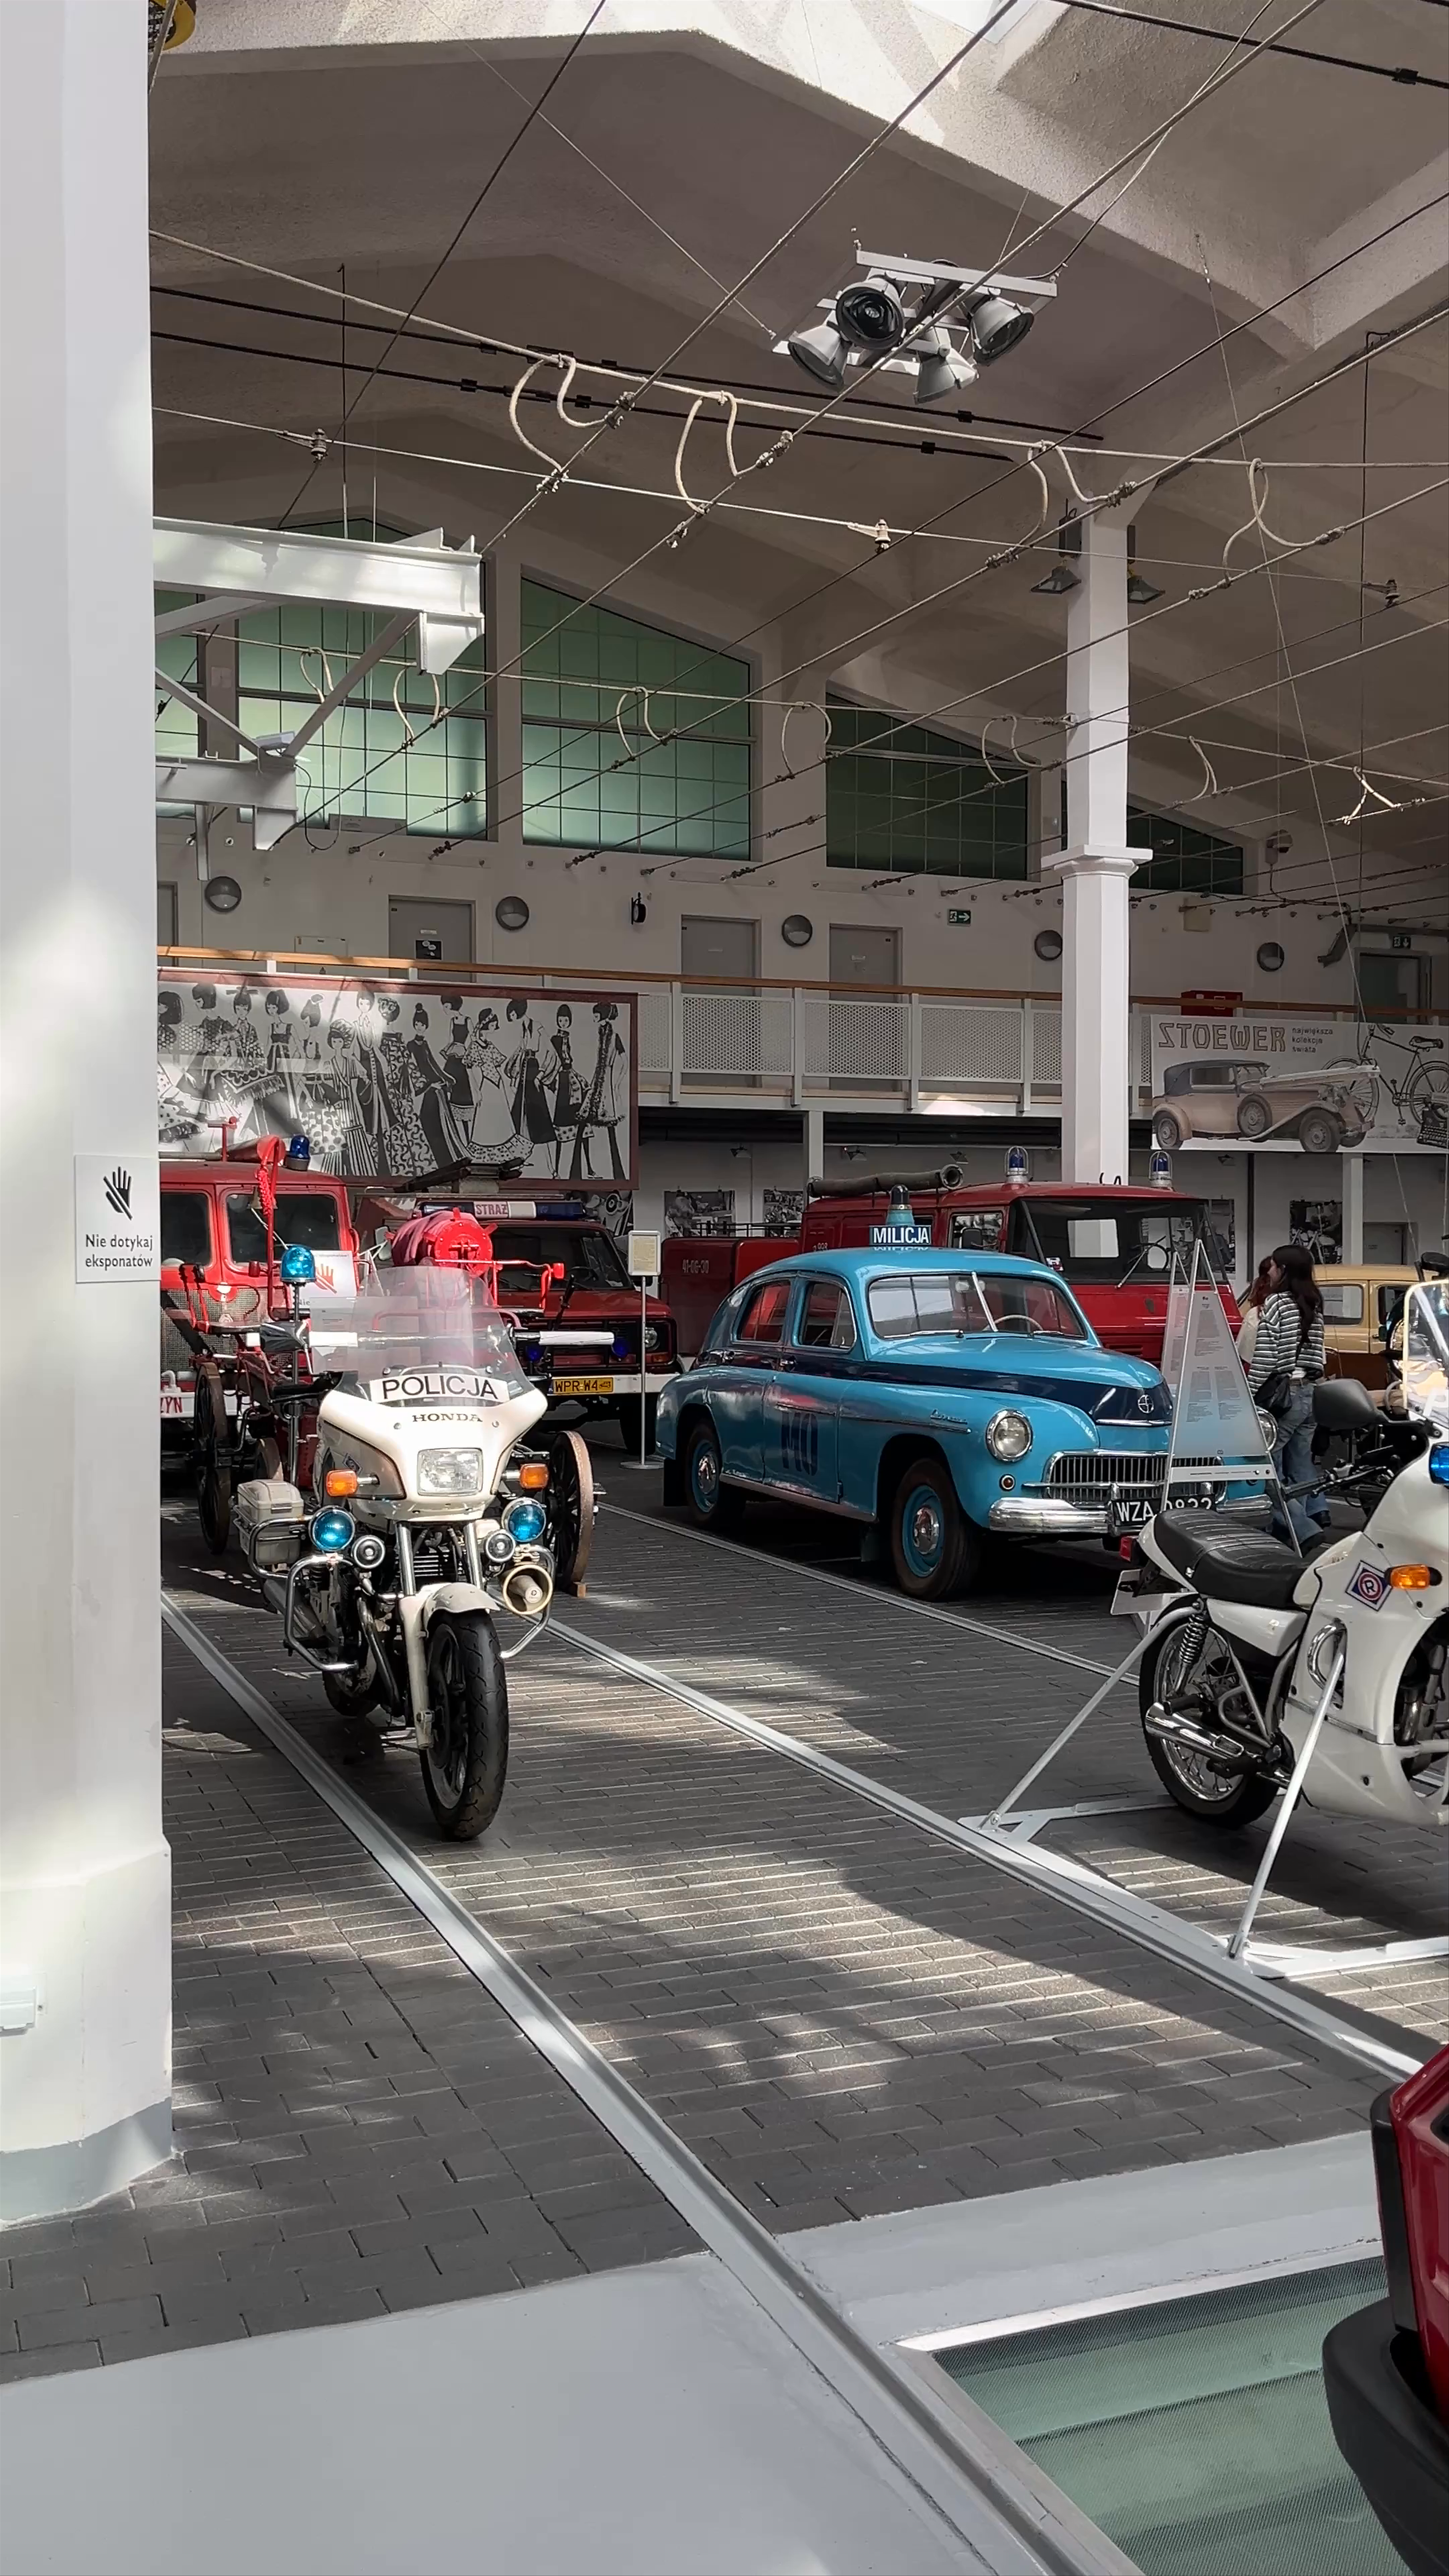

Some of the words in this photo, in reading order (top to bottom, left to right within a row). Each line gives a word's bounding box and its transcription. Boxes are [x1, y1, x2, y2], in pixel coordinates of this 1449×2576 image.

[1159, 1023, 1286, 1052] STOEWER
[86, 1234, 106, 1247] Nie
[110, 1235, 152, 1252] dotykaj
[874, 1227, 929, 1243] MILICJA
[85, 1254, 152, 1271] eksponatów
[382, 1375, 498, 1399] POLICJA
[555, 1381, 580, 1392] WPR
[412, 1413, 483, 1422] HONDA
[1116, 1501, 1155, 1522] WZA
